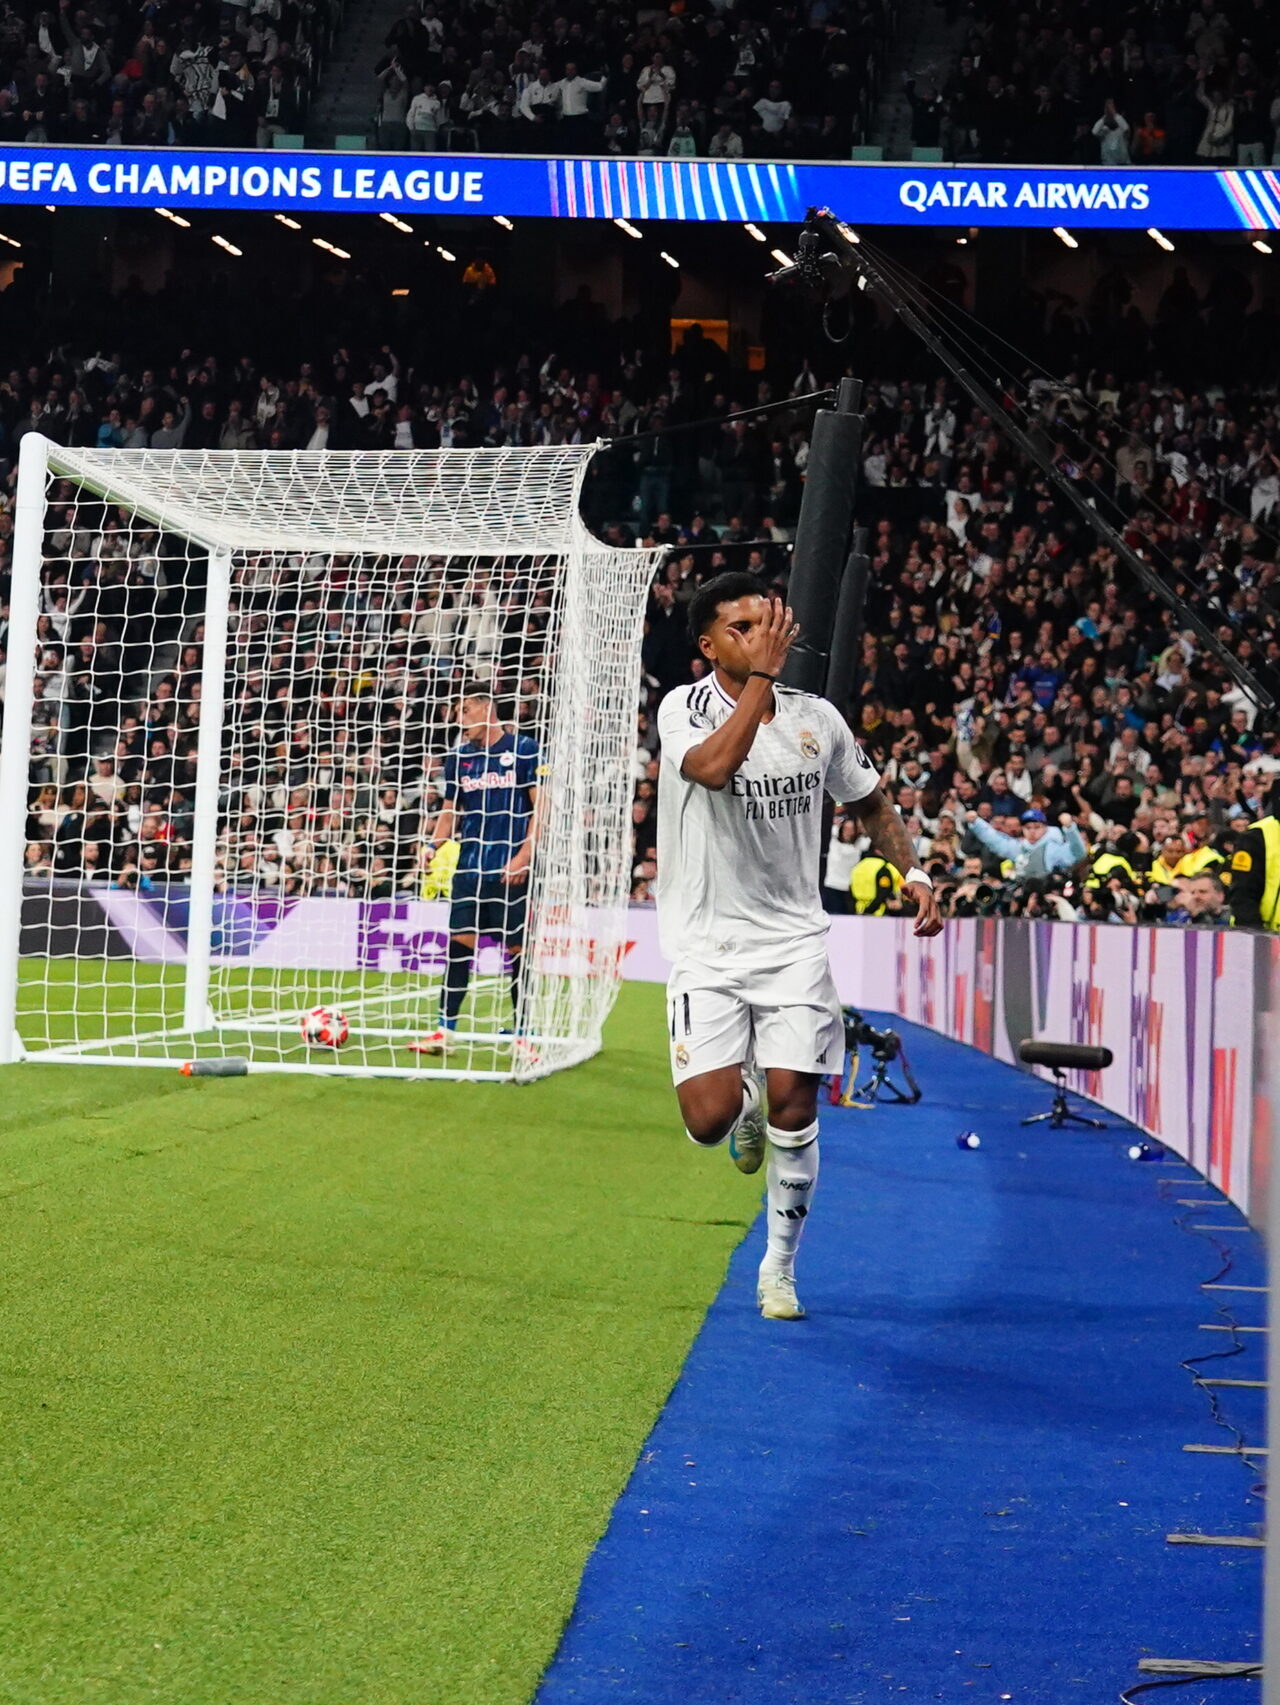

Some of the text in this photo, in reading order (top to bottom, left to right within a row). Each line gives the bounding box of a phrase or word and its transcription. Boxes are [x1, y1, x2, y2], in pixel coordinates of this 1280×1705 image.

[88, 163, 322, 198] CHAMPIONS
[333, 168, 484, 203] LEAGUE
[899, 180, 1150, 213] QATAR AIRWAYS
[730, 770, 820, 798] Emirates
[769, 795, 811, 819] BETTER
[671, 992, 692, 1042] 11
